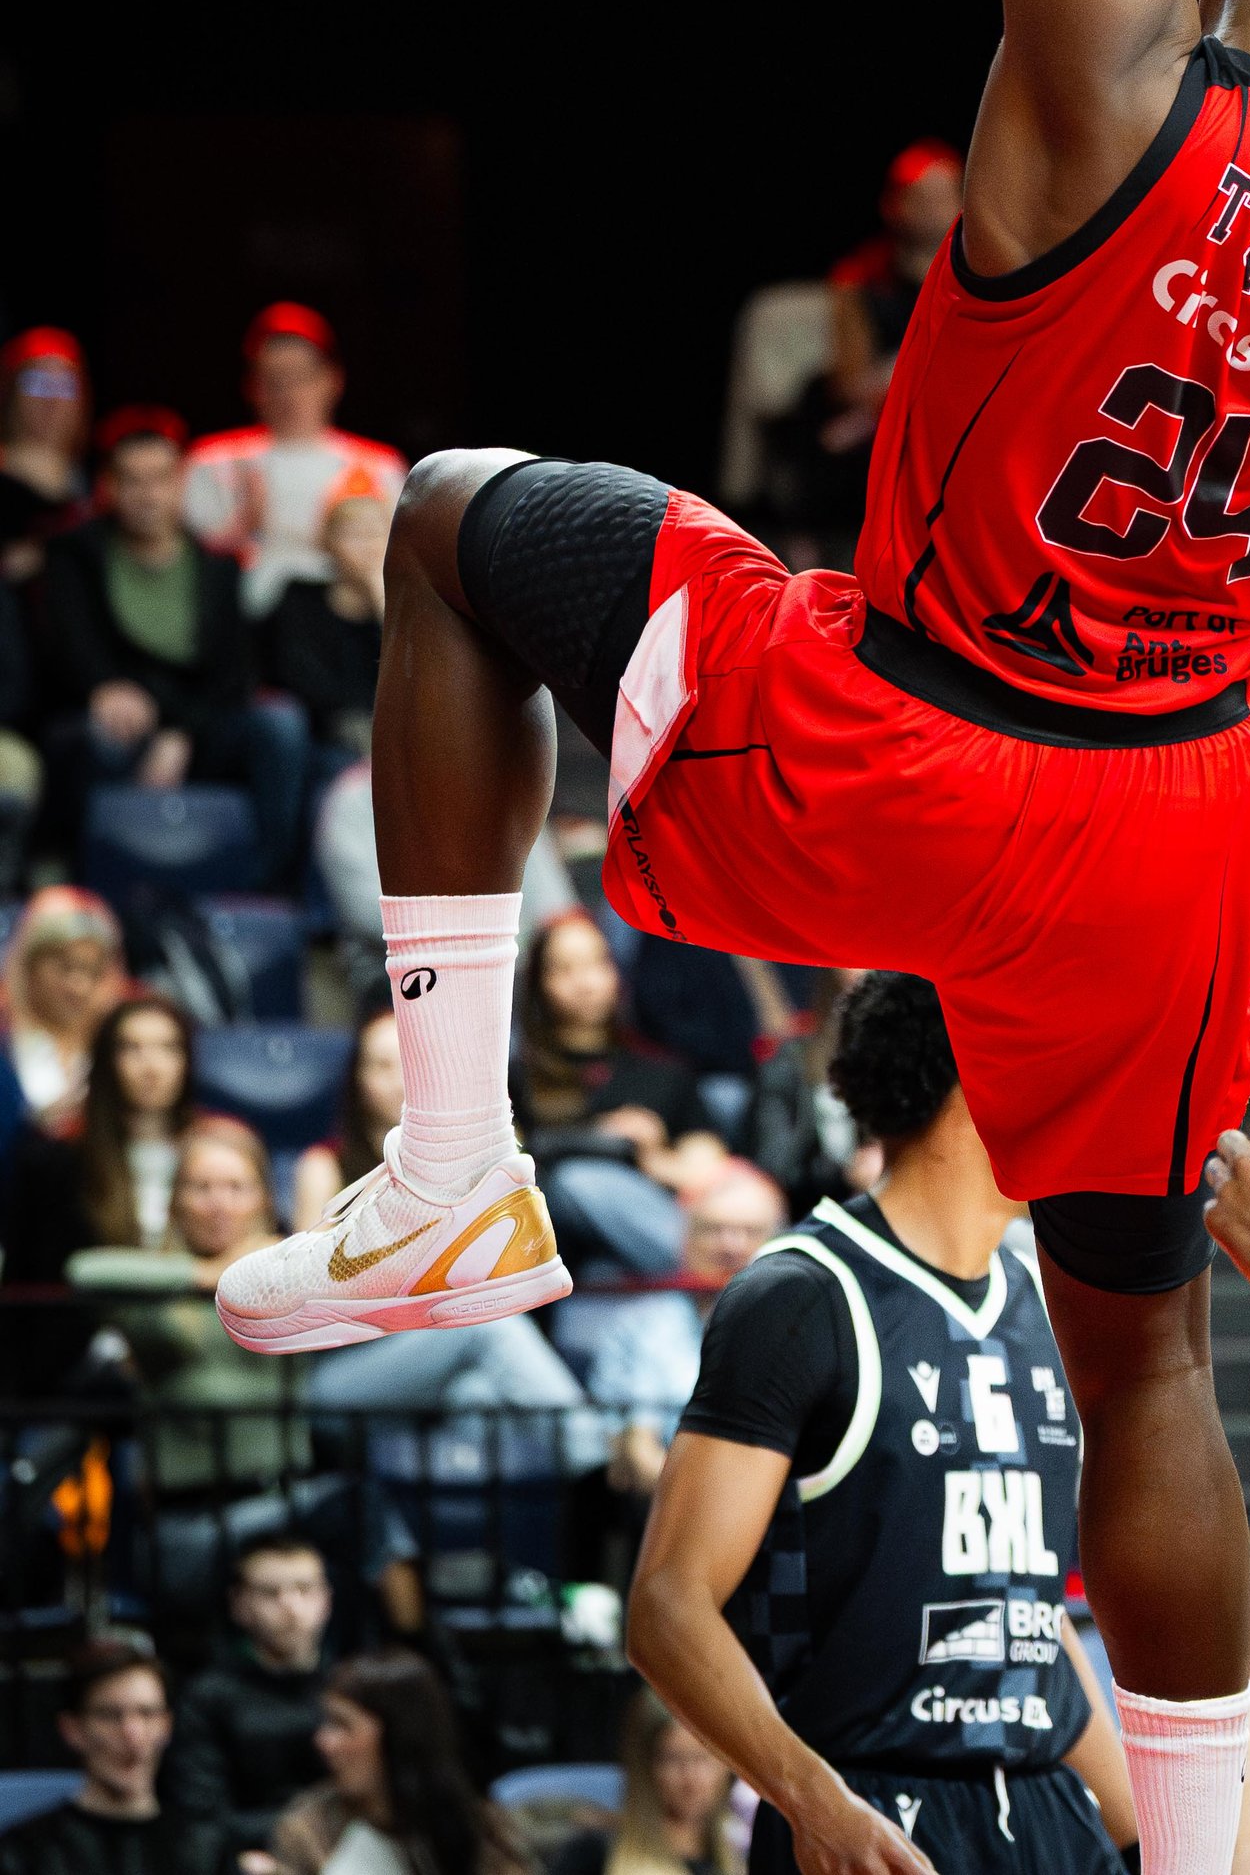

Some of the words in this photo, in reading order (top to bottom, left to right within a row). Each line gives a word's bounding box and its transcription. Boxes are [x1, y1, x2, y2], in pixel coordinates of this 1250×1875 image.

[1122, 602, 1200, 632] Port
[1115, 642, 1228, 684] Bruges
[966, 1353, 1021, 1454] 6
[941, 1469, 1060, 1576] BXL
[910, 1685, 1020, 1724] Circus
